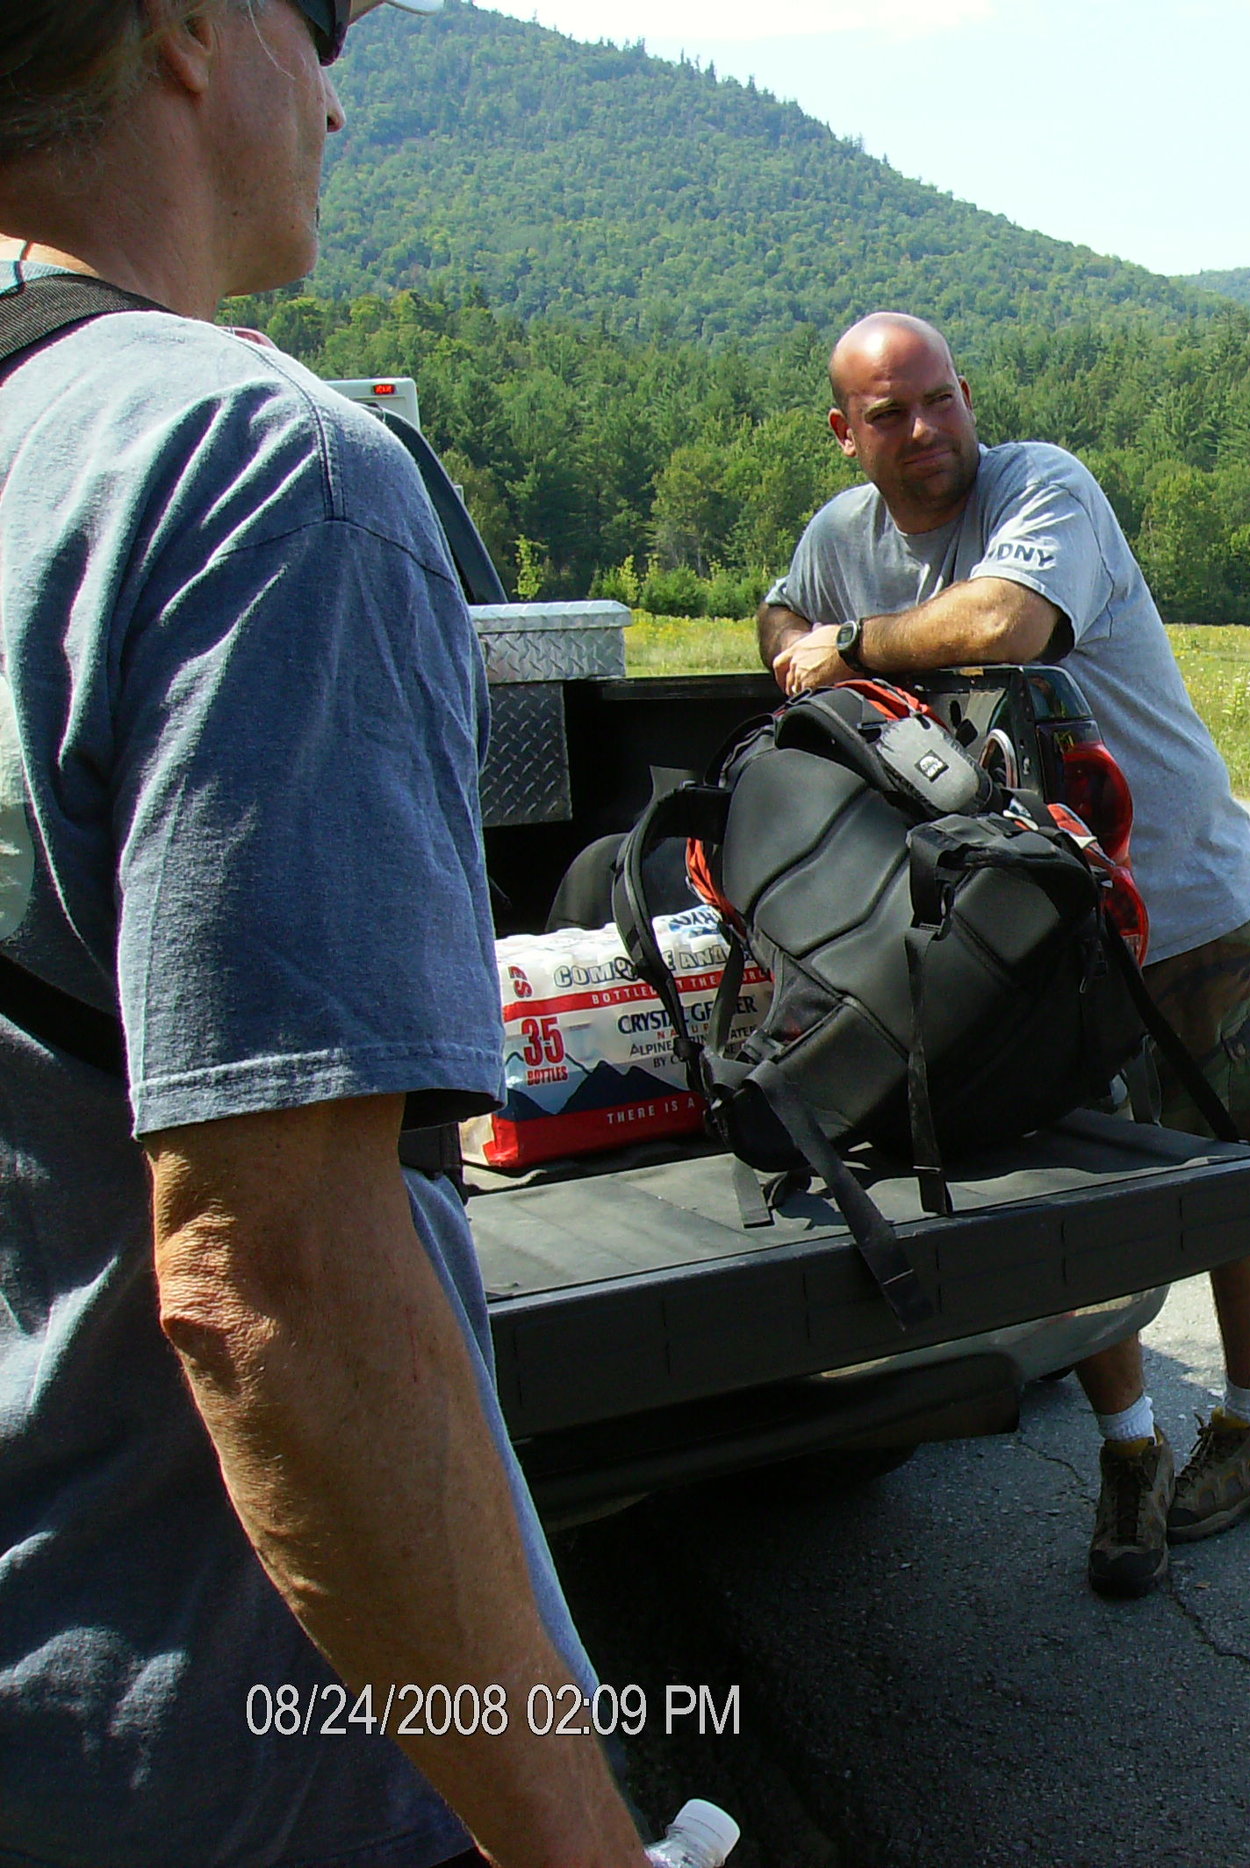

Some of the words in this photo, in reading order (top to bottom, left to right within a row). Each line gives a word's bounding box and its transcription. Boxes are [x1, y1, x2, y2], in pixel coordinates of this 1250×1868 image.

[680, 943, 728, 970] AND
[691, 974, 717, 989] THE
[521, 1016, 565, 1067] 35
[629, 1040, 674, 1058] ALPINE
[653, 1056, 667, 1069] BY
[526, 1065, 569, 1087] BOTTLES
[607, 1104, 656, 1125] THERE
[664, 1100, 678, 1113] IS
[687, 1096, 696, 1109] A
